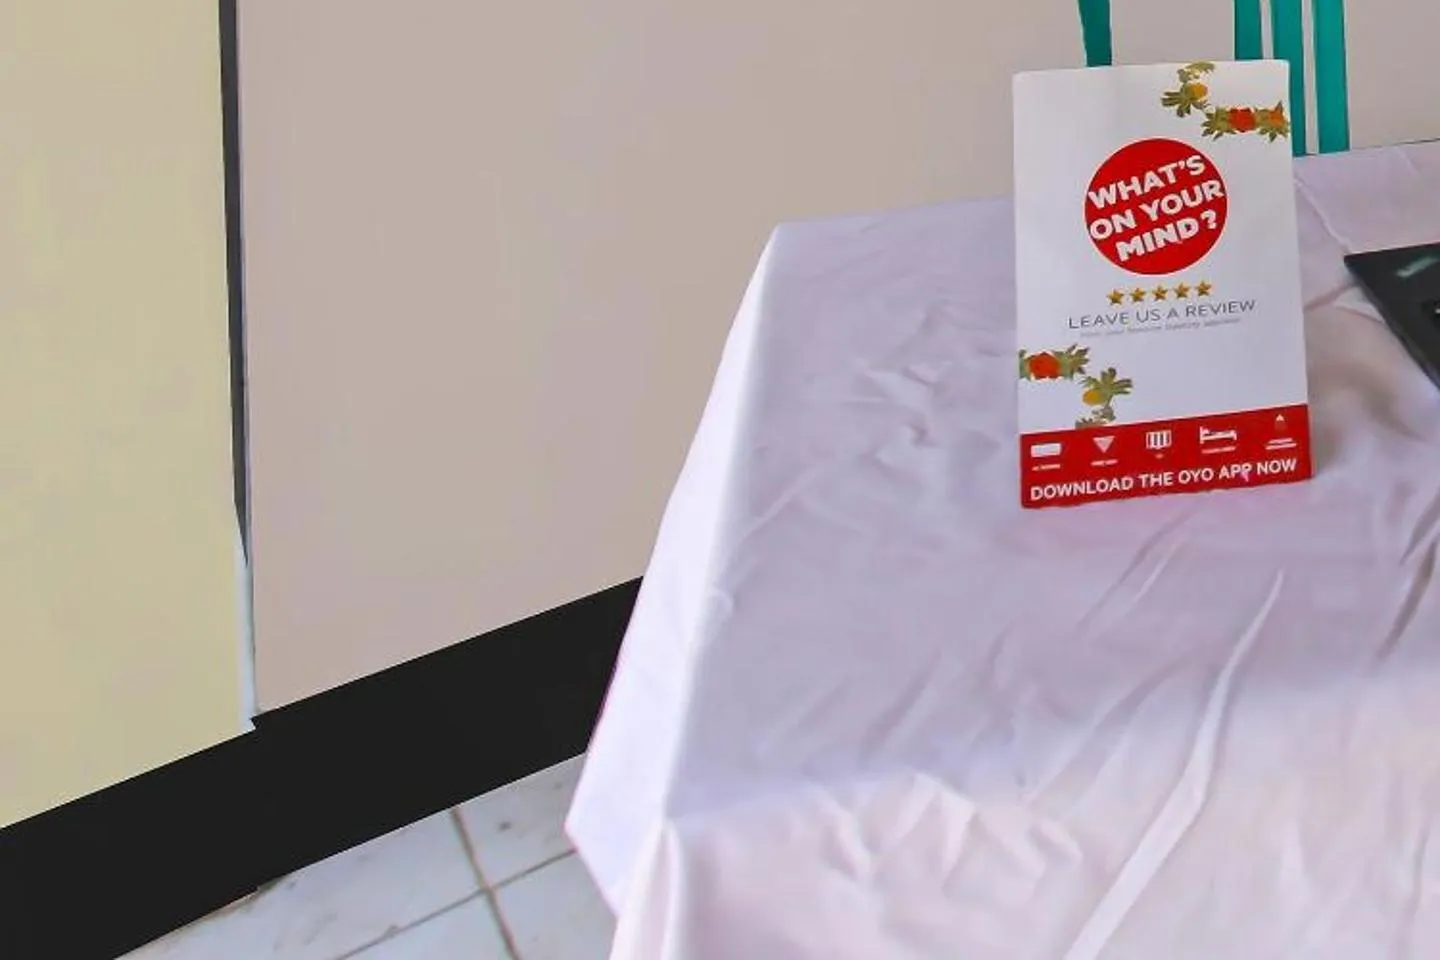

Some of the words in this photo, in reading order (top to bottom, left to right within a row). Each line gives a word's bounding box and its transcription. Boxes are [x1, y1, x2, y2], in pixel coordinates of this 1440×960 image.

[1088, 154, 1206, 210] WHAT'S
[1089, 209, 1136, 241] ON
[1138, 178, 1225, 223] YOUR
[1068, 312, 1129, 330] LEAVE
[1136, 309, 1161, 323] US
[1166, 308, 1179, 320] A
[1185, 299, 1257, 318] REVIEW
[1030, 478, 1134, 501] DOWNLOAD
[1139, 471, 1173, 488] THE
[1178, 466, 1214, 484] OYO
[1218, 461, 1252, 479] APP
[1256, 458, 1297, 476] NOW
